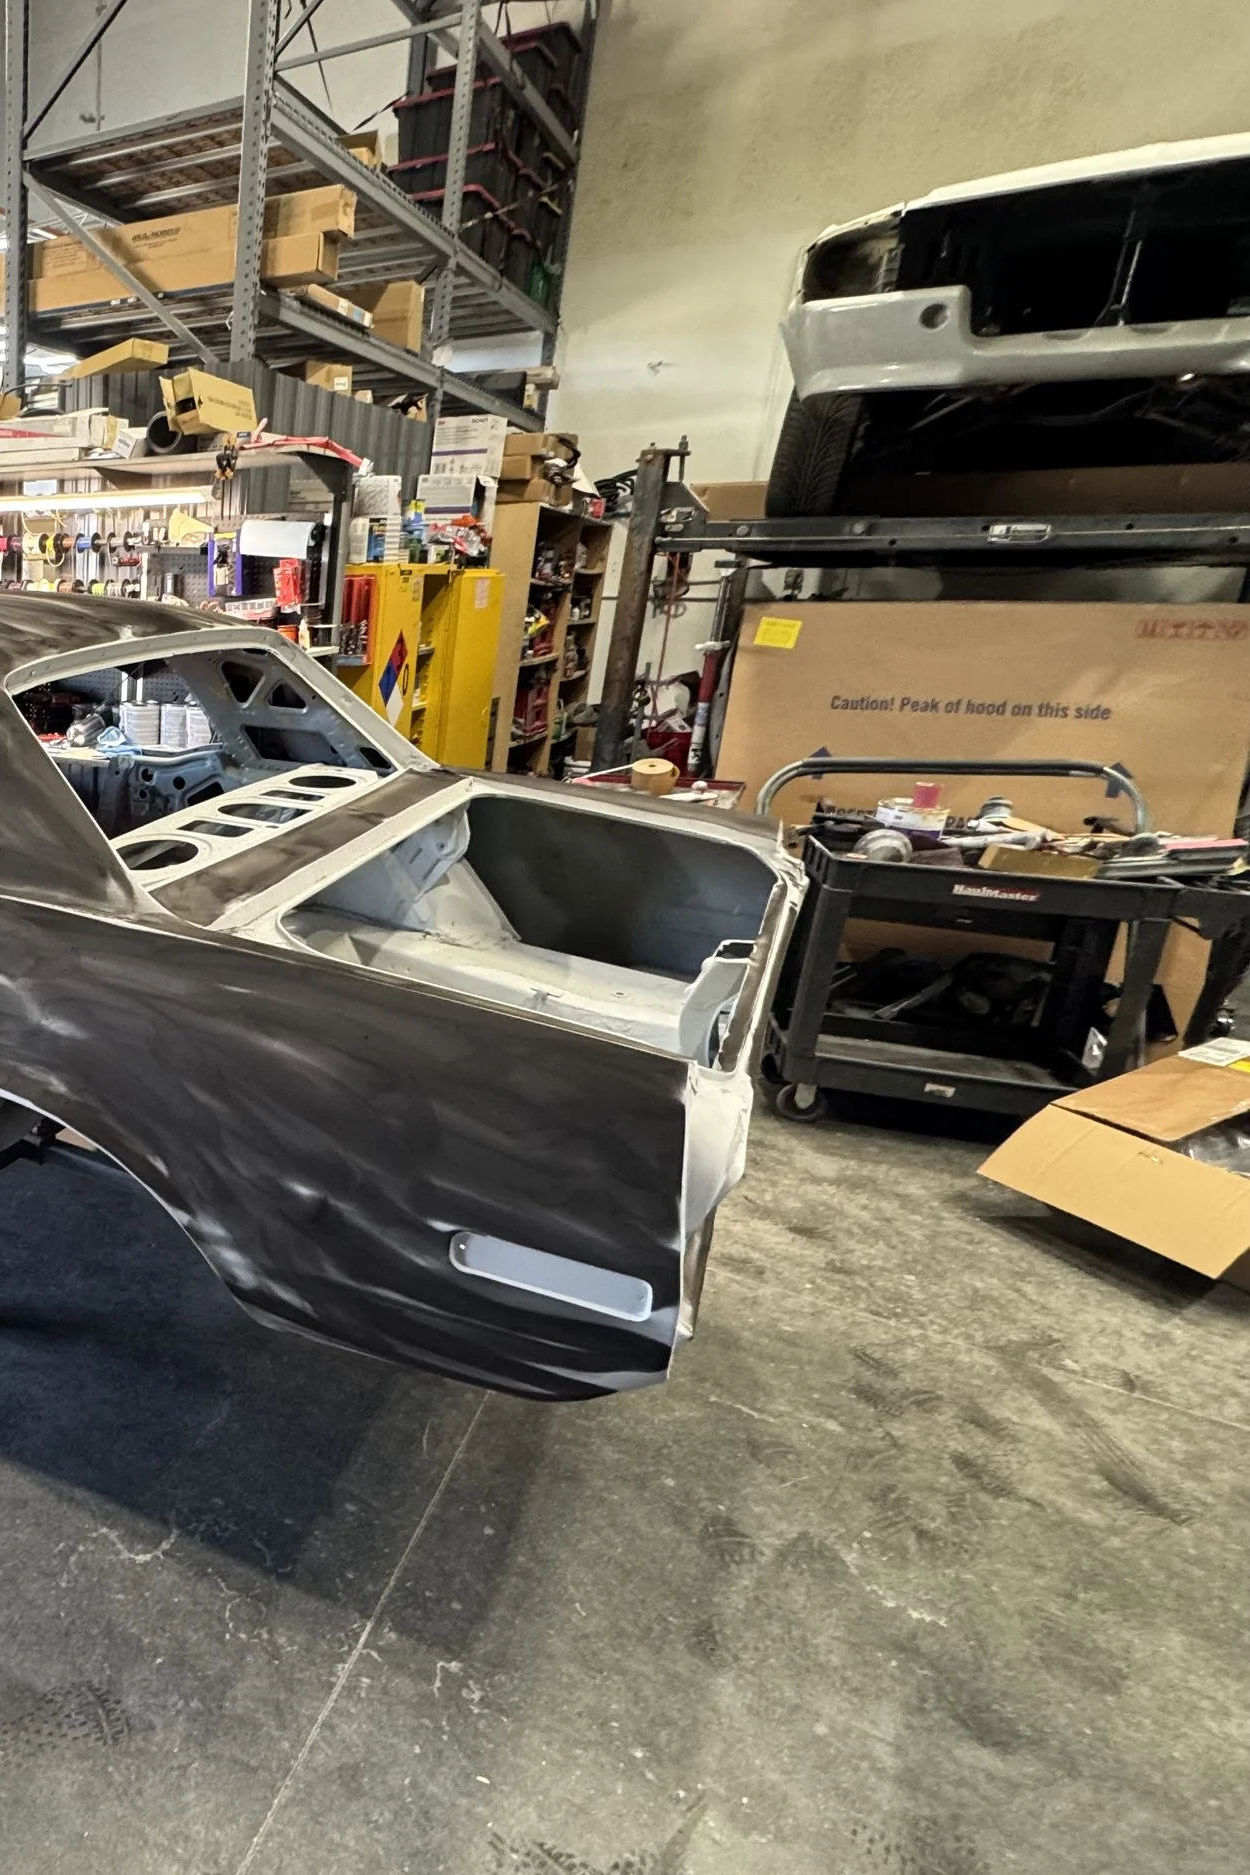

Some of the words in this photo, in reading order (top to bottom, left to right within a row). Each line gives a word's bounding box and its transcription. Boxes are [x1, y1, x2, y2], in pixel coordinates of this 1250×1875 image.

[830, 695, 896, 711] Caution!
[899, 696, 940, 713] Peak
[944, 698, 963, 714] of
[965, 699, 1008, 716] hood
[1011, 703, 1033, 717] on
[1037, 702, 1070, 719] this
[1074, 704, 1112, 720] side
[952, 884, 1040, 901] HaulMaster
